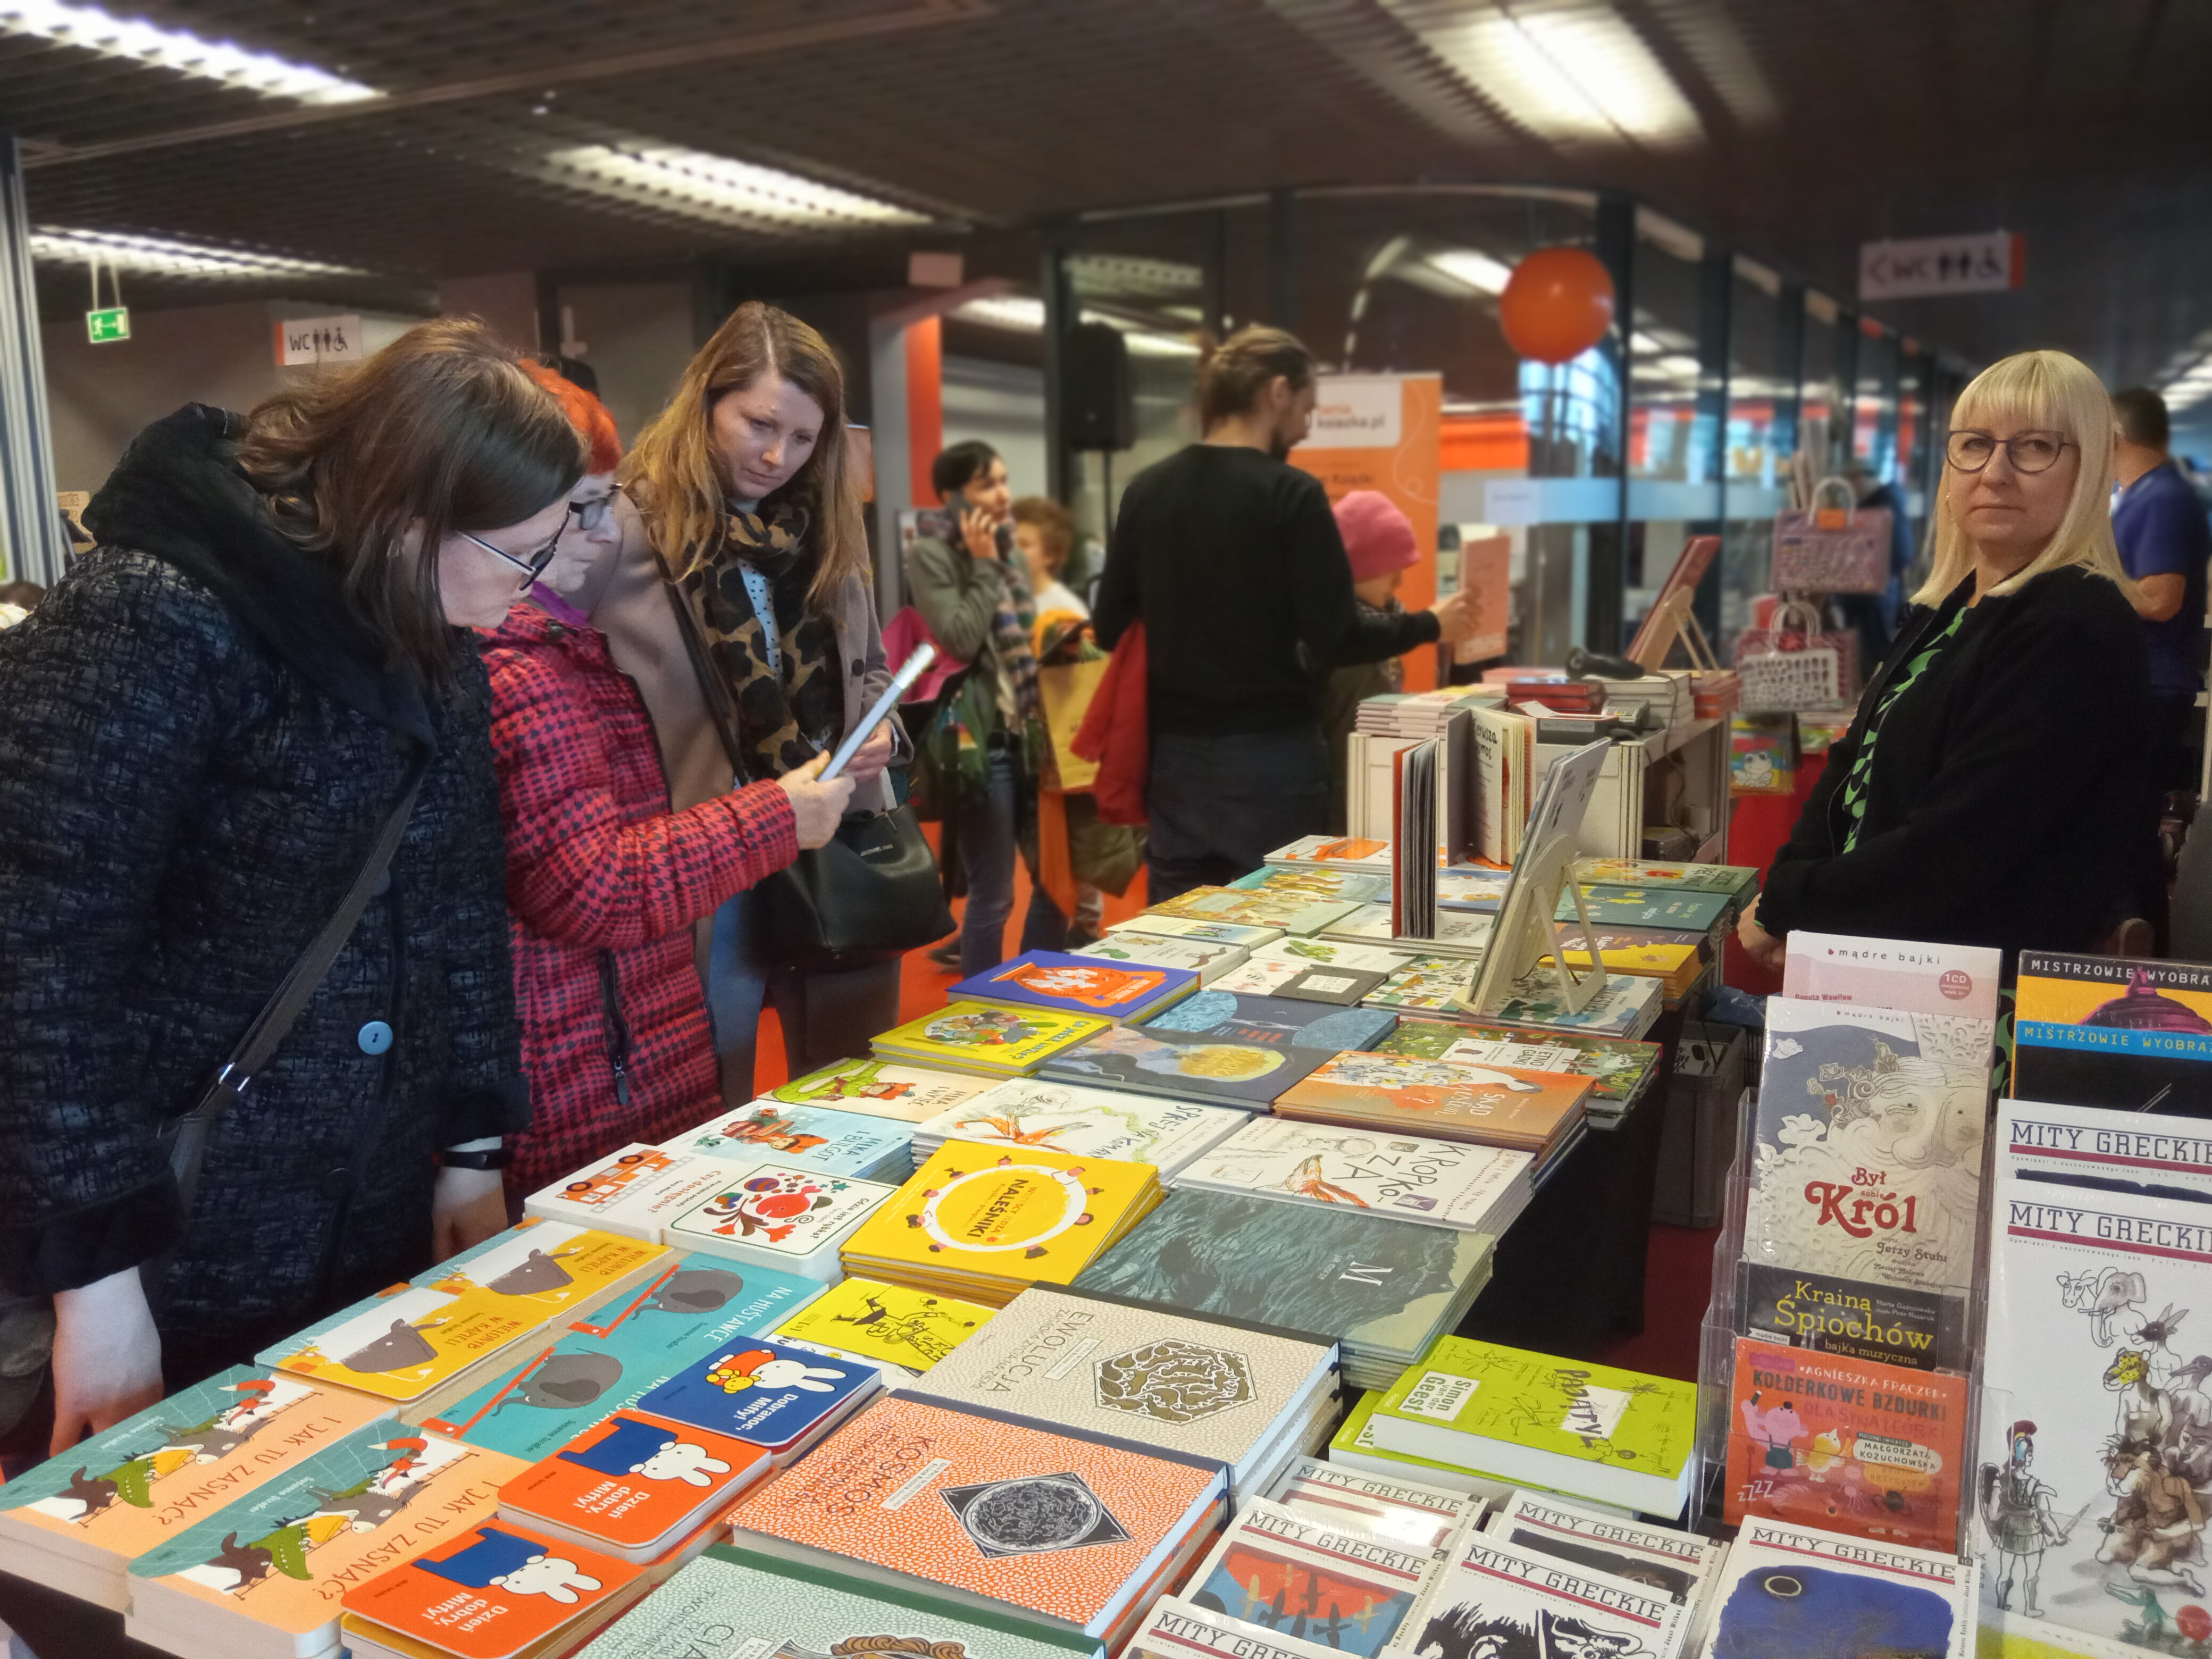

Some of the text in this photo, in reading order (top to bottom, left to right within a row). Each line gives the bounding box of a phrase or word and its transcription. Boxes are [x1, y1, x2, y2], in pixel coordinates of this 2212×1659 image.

[1893, 256, 1930, 281] WC
[289, 334, 310, 351] WC
[1839, 949, 1940, 965] mądre bajki
[2031, 960, 2134, 979] MISTRZOWIE
[2025, 1027, 2129, 1046] MISTRZOWIE
[1513, 1049, 1536, 1065] GADKI
[1530, 1051, 1553, 1066] ETNO
[907, 1089, 943, 1107] WYJEC
[932, 1090, 967, 1105] MIKA
[811, 1133, 863, 1162] BULGOT
[842, 1137, 882, 1155] MIKA
[2011, 1122, 2083, 1150] MITY
[1332, 1154, 1402, 1179] ZA
[1851, 1167, 1887, 1186] Był
[650, 1170, 722, 1213] Czy dosięgnie?
[847, 1197, 869, 1212] Gdzie
[1861, 1190, 1885, 1200] sobie
[832, 1209, 850, 1224] jest
[967, 1178, 1029, 1237] NALEŚNIKI
[1805, 1180, 1917, 1238] Król
[2009, 1203, 2083, 1234] MITY
[599, 1250, 649, 1276] WIELORYB
[1876, 1242, 1911, 1258] Jerzy
[1795, 1280, 1871, 1311] Kraina
[703, 1286, 793, 1343] NA HUŚTAWCE
[1774, 1294, 1934, 1350] Śpiochów
[467, 1321, 524, 1350] WIELORYB
[1755, 1331, 1788, 1344] mądre bajki
[985, 1311, 1095, 1392] EWOLUCJA
[1825, 1339, 1918, 1365] bajka muzyczna
[1805, 1365, 1878, 1388] AGNIESZKA
[733, 1396, 773, 1420] Miffy!
[1403, 1376, 1446, 1414] Geest
[1427, 1384, 1449, 1410] van der
[1437, 1380, 1472, 1412] Simon
[1753, 1370, 1947, 1421] KOŁDERKOWE BZDURKI
[735, 1393, 799, 1430] Dobranoc,
[1804, 1401, 1833, 1419] DLA
[283, 1423, 329, 1446] JAK
[254, 1449, 288, 1464] TU
[1860, 1451, 1936, 1470] KOŻUCHOWSKA
[1864, 1442, 1931, 1460] MAŁGORZATA
[482, 1480, 501, 1489] I
[826, 1435, 935, 1516] KOSMOS
[152, 1464, 255, 1525] ZASNĄĆ?
[442, 1488, 490, 1514] JAK
[573, 1481, 617, 1509] Miffy!
[585, 1486, 631, 1514] dobry,
[1296, 1467, 1462, 1513] MITY GRECKIE
[608, 1491, 651, 1519] Dzień
[414, 1516, 450, 1534] TU
[1518, 1503, 1704, 1559] MITY GRECKIE
[1245, 1512, 1428, 1575] MITY GRECKIE
[1752, 1528, 1824, 1552] MITY
[1834, 1544, 1956, 1579] GRECKIE
[312, 1534, 417, 1601] ZASNĄĆ?
[1465, 1547, 1668, 1621] MITY GRECKIE
[422, 1592, 473, 1620] Miffy!
[434, 1598, 488, 1626] dobry,
[458, 1605, 509, 1633] Dzień
[1154, 1613, 1227, 1647] MITY
